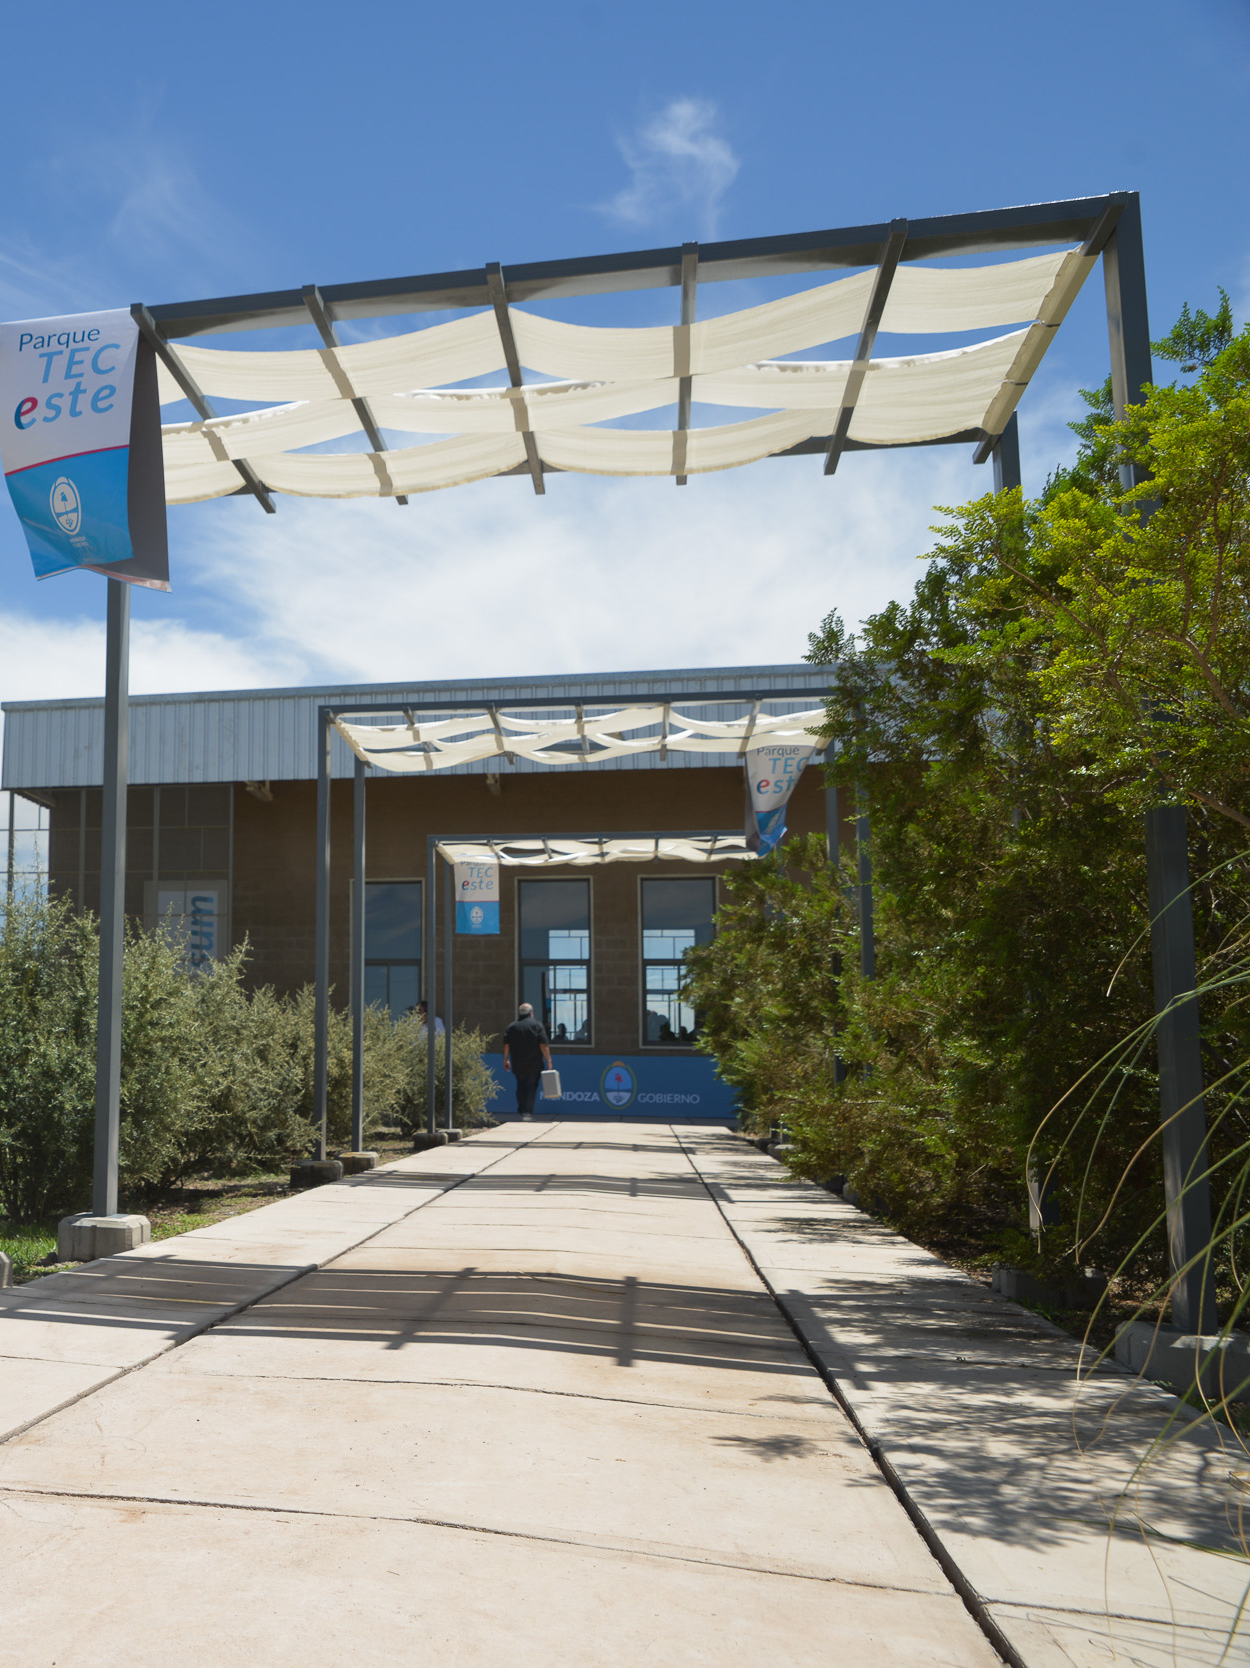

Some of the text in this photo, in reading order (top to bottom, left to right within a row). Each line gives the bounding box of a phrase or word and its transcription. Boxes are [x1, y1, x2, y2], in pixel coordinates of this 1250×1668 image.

[18, 327, 101, 352] Parque
[38, 343, 121, 384] TEC
[14, 381, 117, 430] este
[756, 746, 800, 757] Parque
[768, 756, 810, 774] TEC
[756, 775, 797, 795] est
[468, 866, 494, 878] TEC
[461, 879, 494, 891] este
[539, 1090, 701, 1104] MNDOZA GOBIERNO
